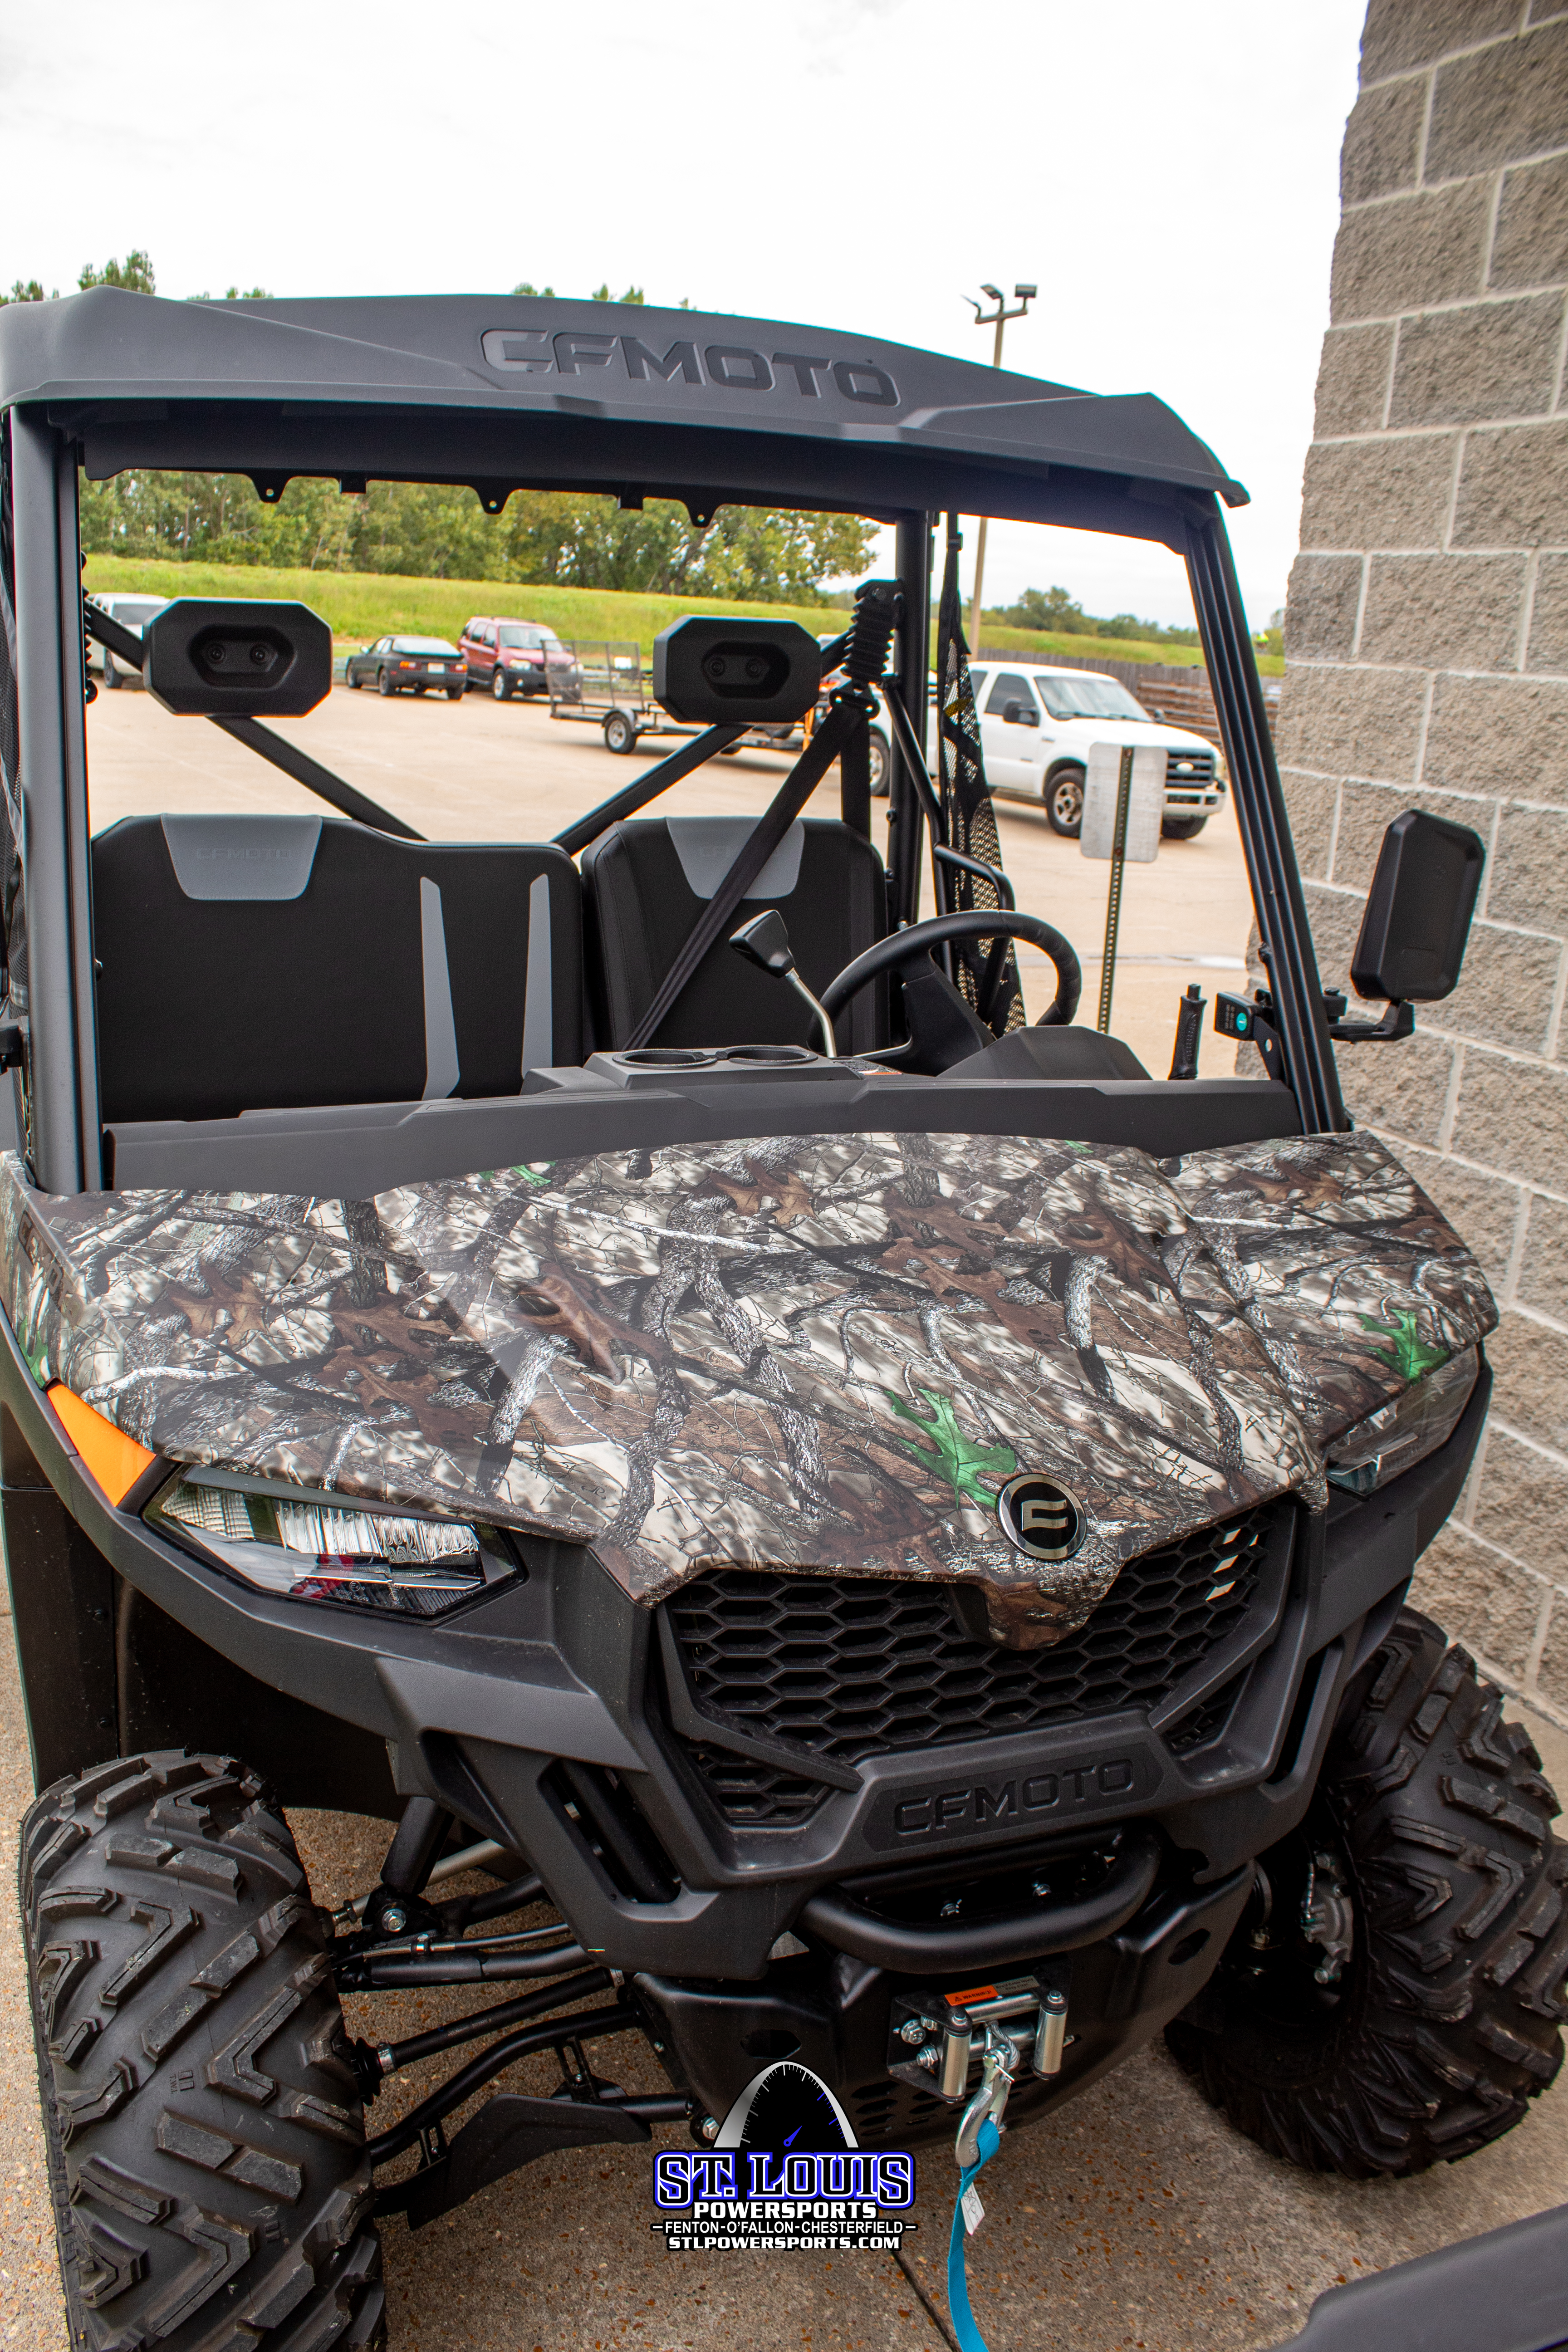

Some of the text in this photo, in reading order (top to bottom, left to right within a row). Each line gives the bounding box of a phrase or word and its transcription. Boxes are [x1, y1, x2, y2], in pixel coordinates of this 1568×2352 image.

[480, 328, 901, 407] CFMOTO
[196, 847, 292, 859] CFMOTO
[894, 1758, 1134, 1836] CFMOTO
